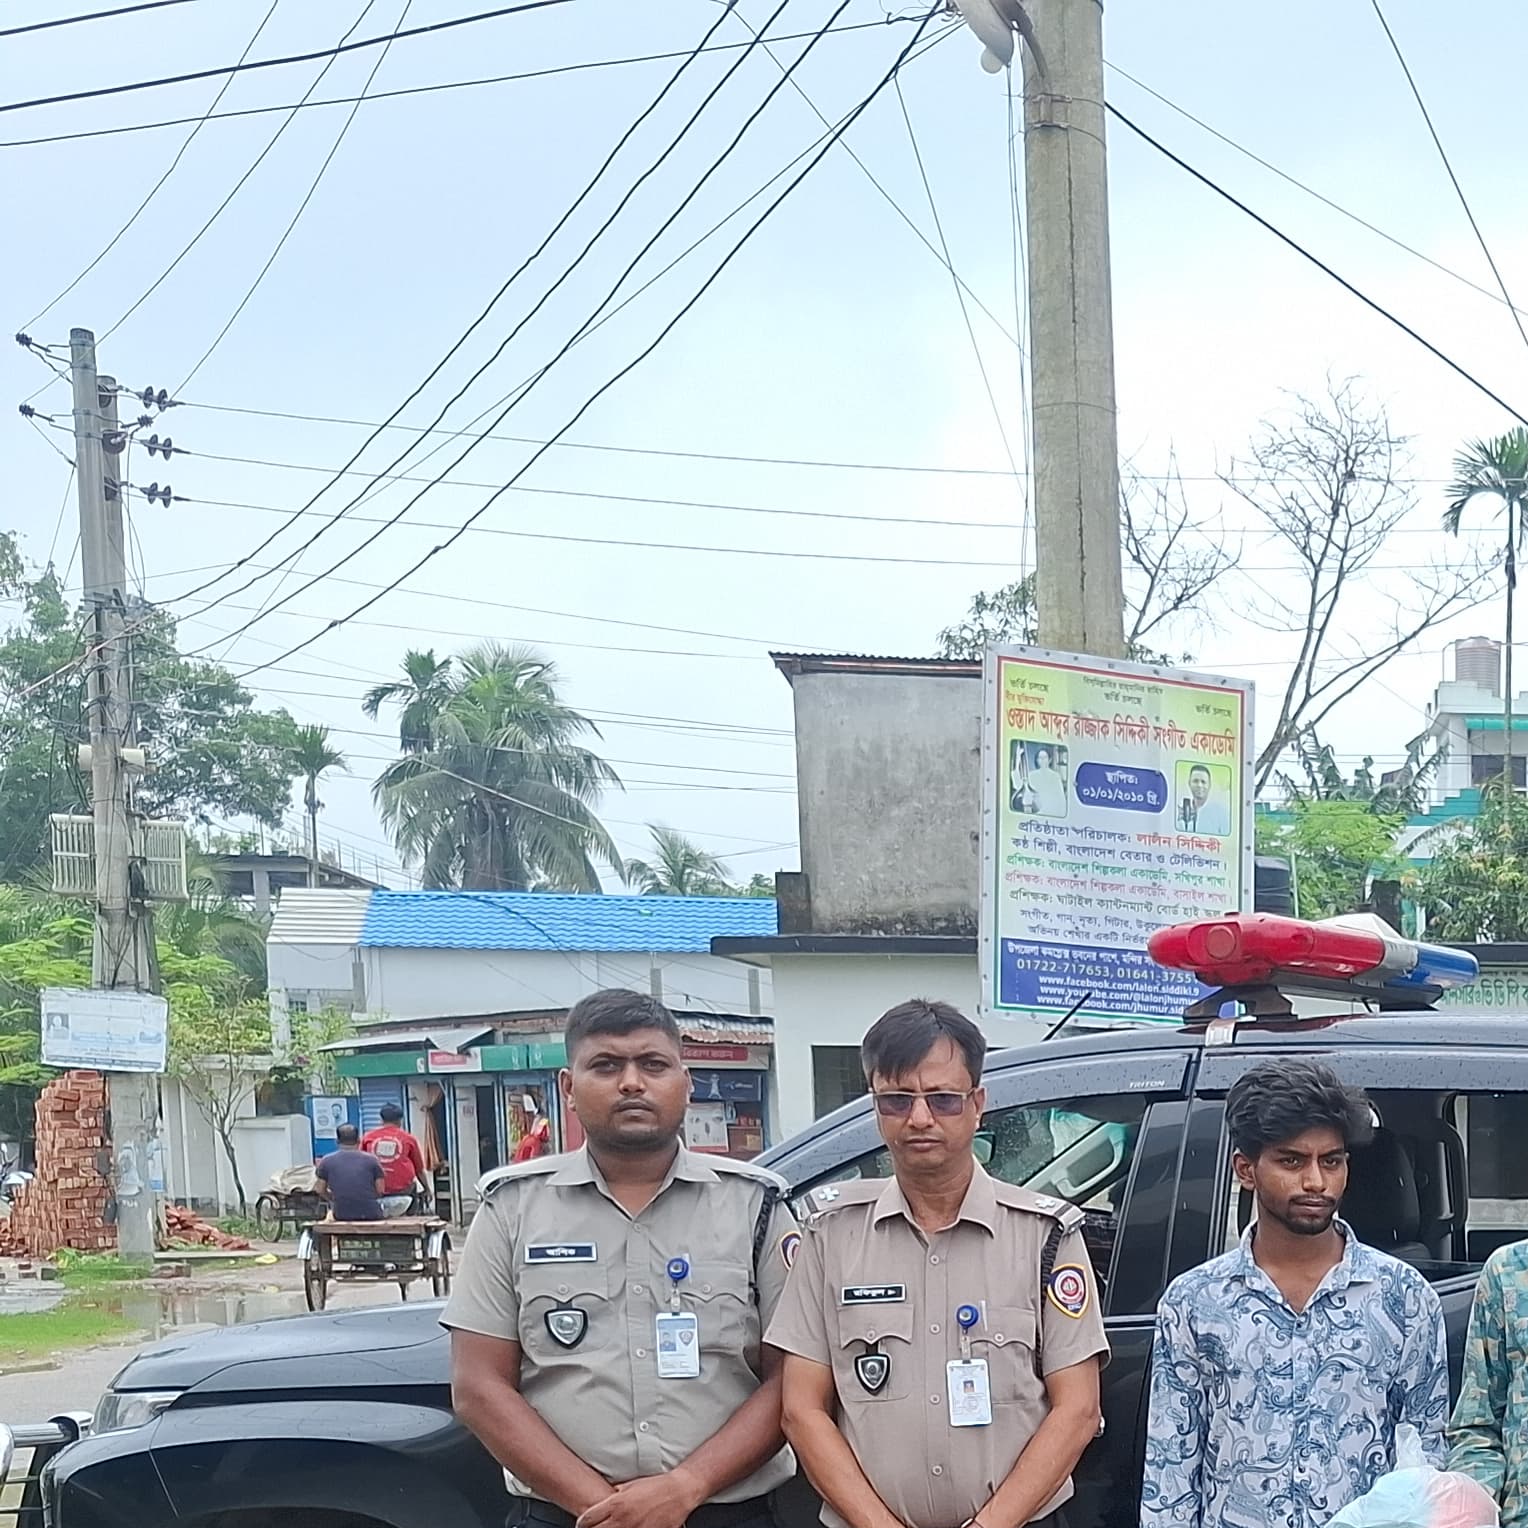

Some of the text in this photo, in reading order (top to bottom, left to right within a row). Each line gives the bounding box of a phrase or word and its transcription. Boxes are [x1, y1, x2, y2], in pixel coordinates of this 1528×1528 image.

[1007, 707, 1236, 758] ওস্তাদ আব্দুর রাজ্জাক সিদ্দিকী সংগীত একাডেমি
[1082, 786, 1145, 802] ০১/০১/২০১০
[1018, 819, 1070, 837] প্রতিষ্ঠাতা
[1176, 834, 1222, 854] সিদ্দিকী
[1065, 844, 1116, 860] বাংলাদেশ
[1120, 850, 1153, 864] বেতার
[1156, 855, 1166, 864] ও
[1048, 859, 1089, 873] বাংলাদেশ
[1046, 876, 1088, 890] বাংলাদেশ
[1016, 958, 1198, 985] 01722-717653, 01641-3755
